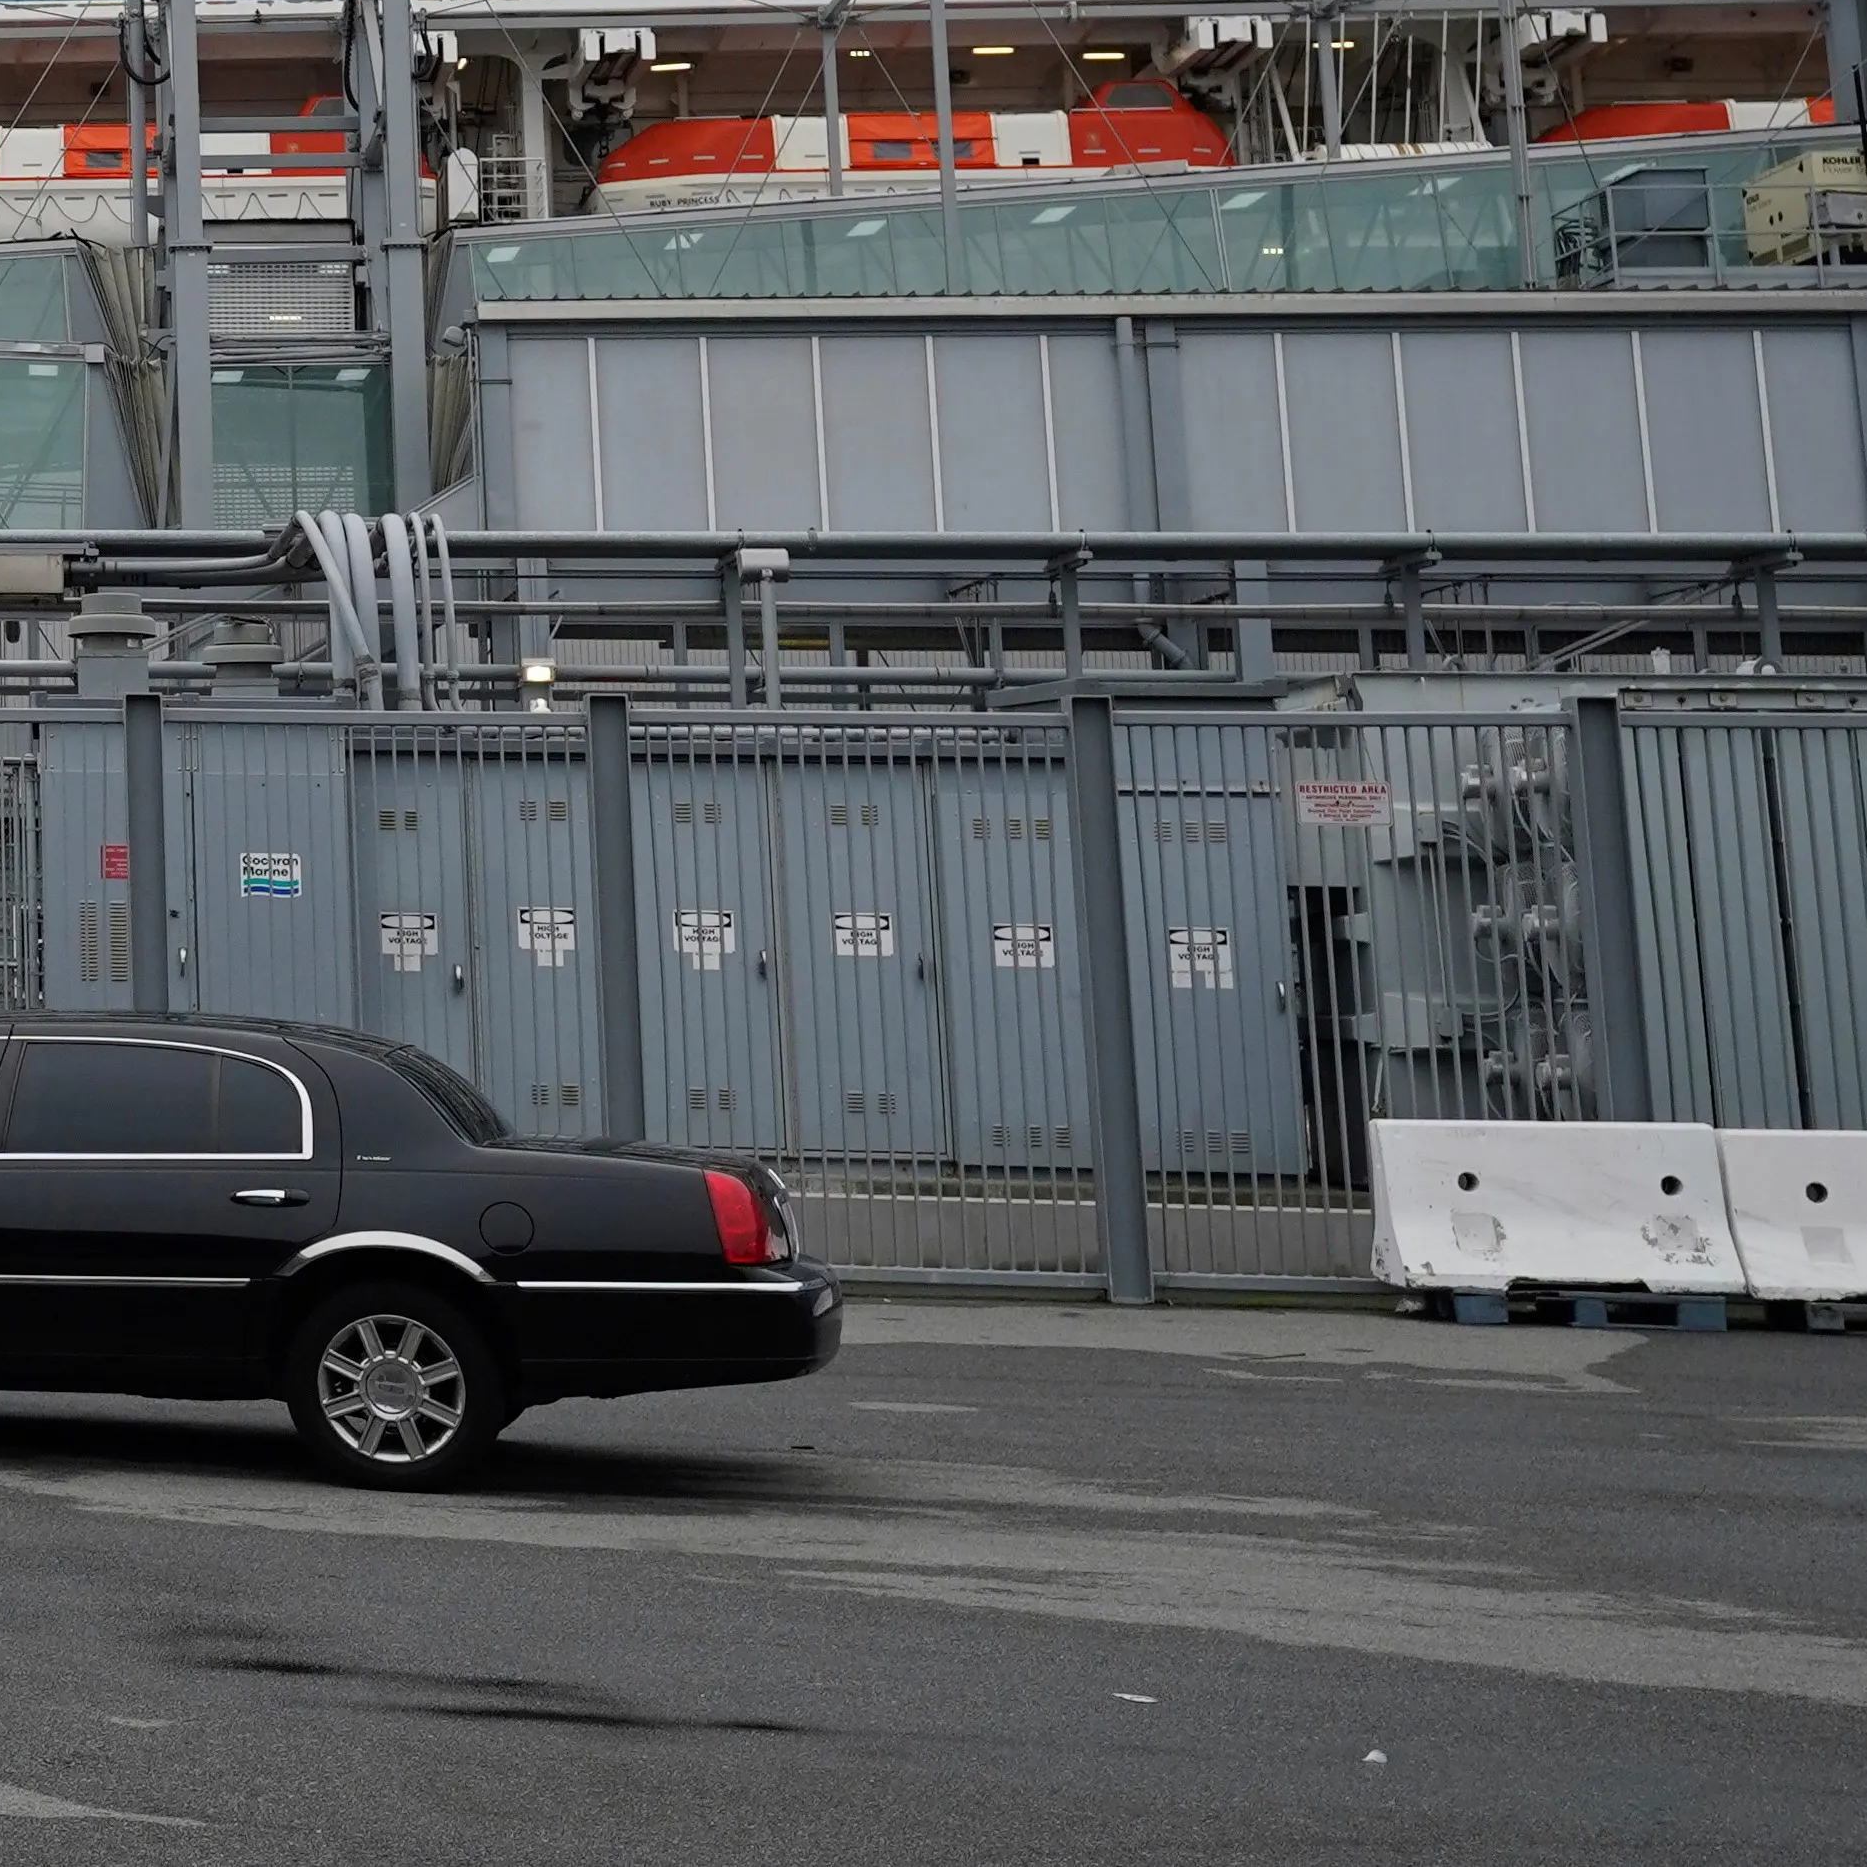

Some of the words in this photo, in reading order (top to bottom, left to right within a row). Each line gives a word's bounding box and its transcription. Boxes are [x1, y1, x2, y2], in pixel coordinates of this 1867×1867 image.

[1822, 156, 1861, 165] KOHLER
[649, 199, 672, 208] RUBY
[677, 195, 720, 206] PRINCESS
[1299, 785, 1357, 794] RESTRICTED
[1361, 785, 1387, 794] AREA
[242, 855, 299, 866] Cochran
[243, 866, 289, 877] Marne
[529, 932, 569, 940] OLTGE
[388, 937, 428, 945] VOTAGE
[1178, 953, 1217, 961] VOTAG
